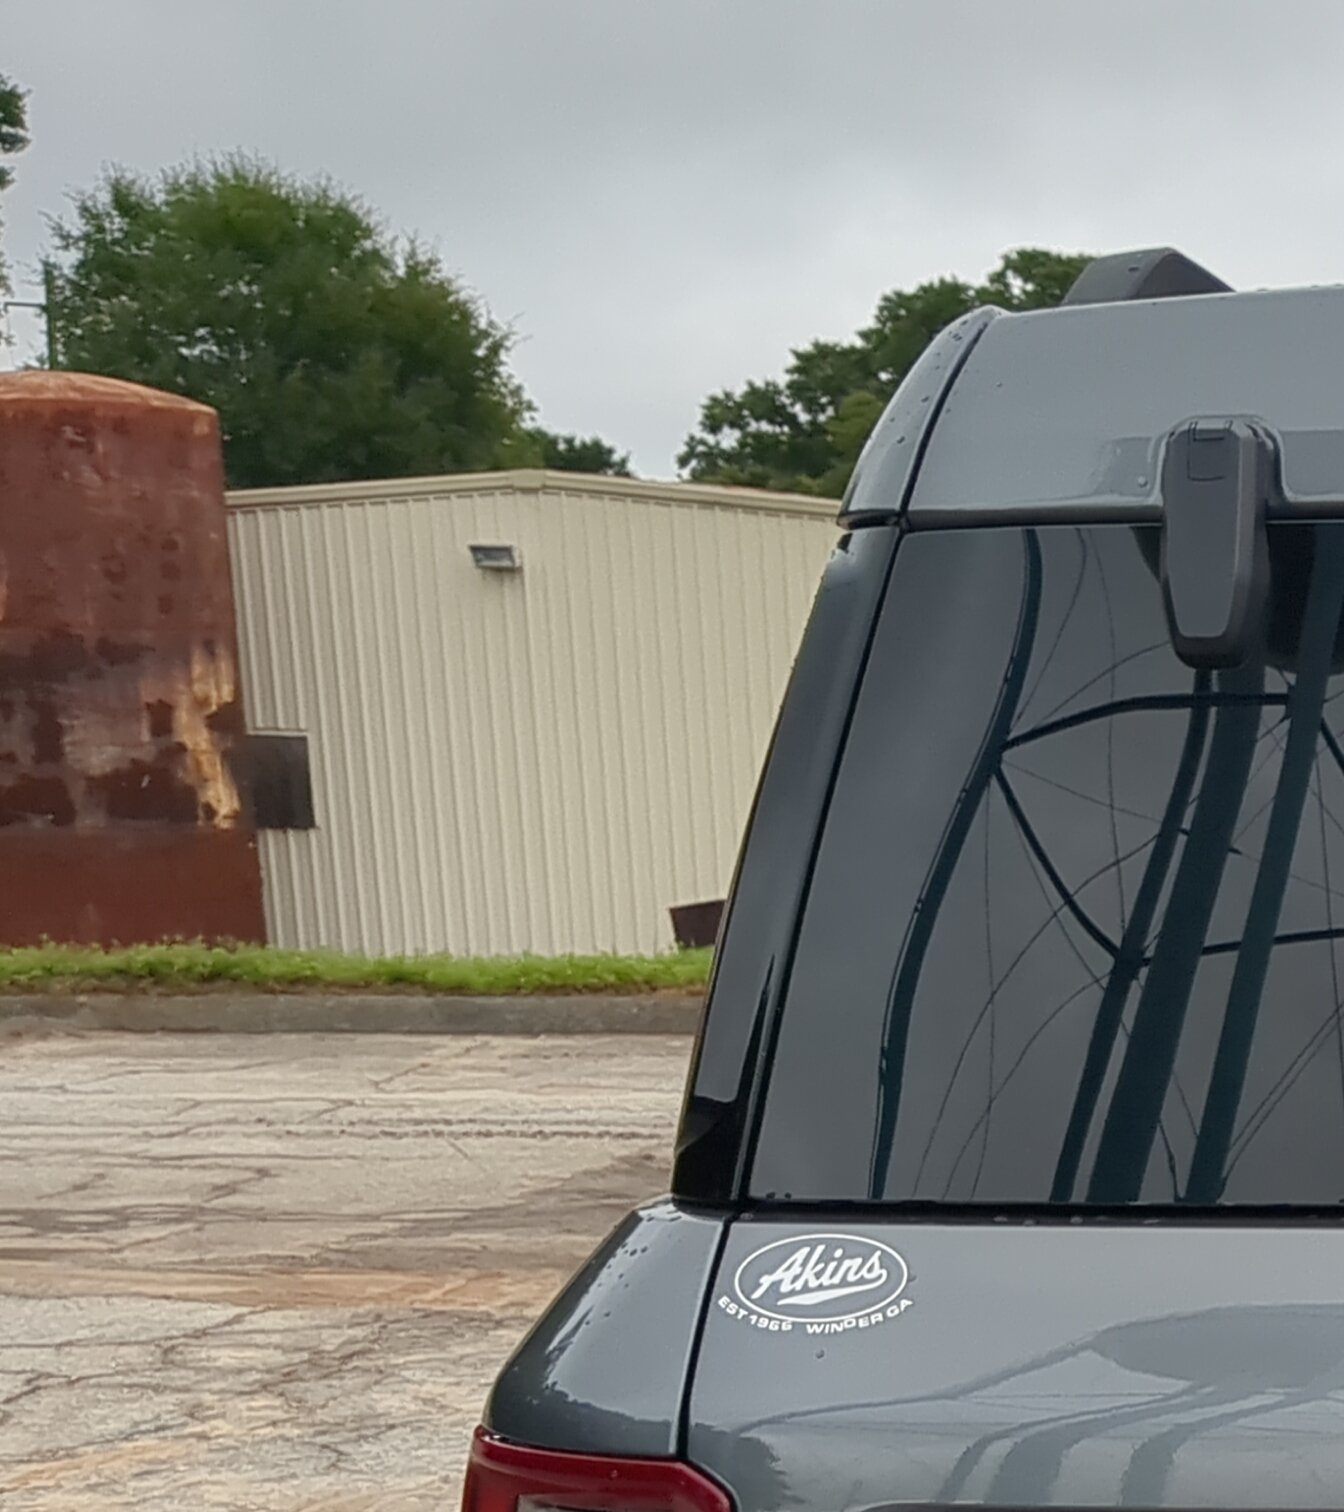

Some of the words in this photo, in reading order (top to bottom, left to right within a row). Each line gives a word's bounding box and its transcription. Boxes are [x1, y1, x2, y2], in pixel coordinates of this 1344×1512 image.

[751, 1244, 888, 1305] Akins
[717, 1295, 749, 1320] EST
[749, 1314, 793, 1331] 1966
[806, 1314, 884, 1334] WINDER
[886, 1298, 914, 1317] GA
